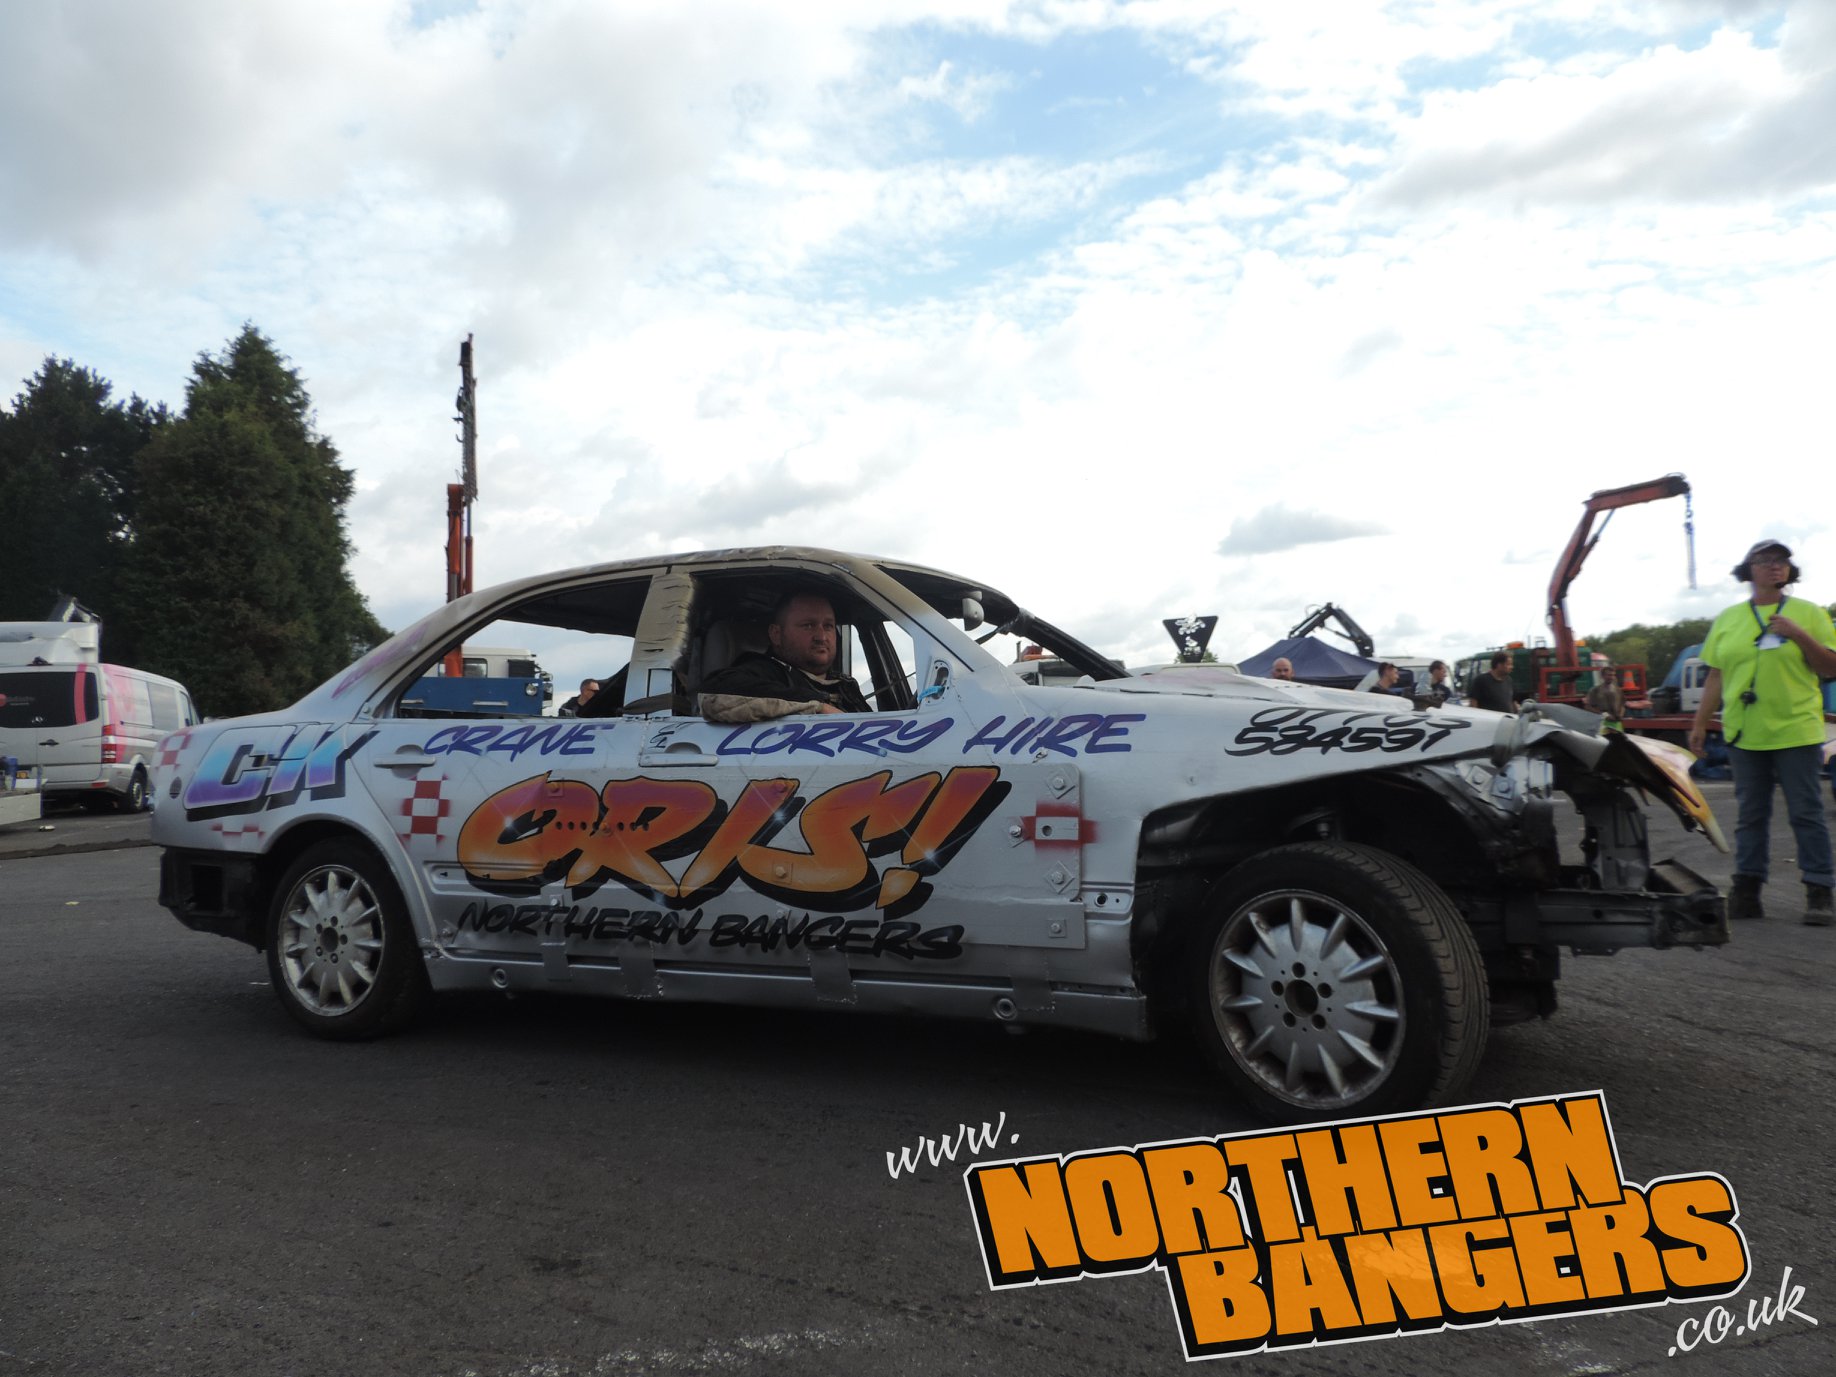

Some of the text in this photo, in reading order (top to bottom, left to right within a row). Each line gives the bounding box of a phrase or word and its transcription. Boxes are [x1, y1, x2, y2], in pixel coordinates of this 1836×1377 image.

[424, 723, 615, 761] CRANE
[716, 717, 954, 758] LORRY
[962, 714, 1147, 758] HIRE
[450, 899, 965, 960] NORTHERN BANGERS
